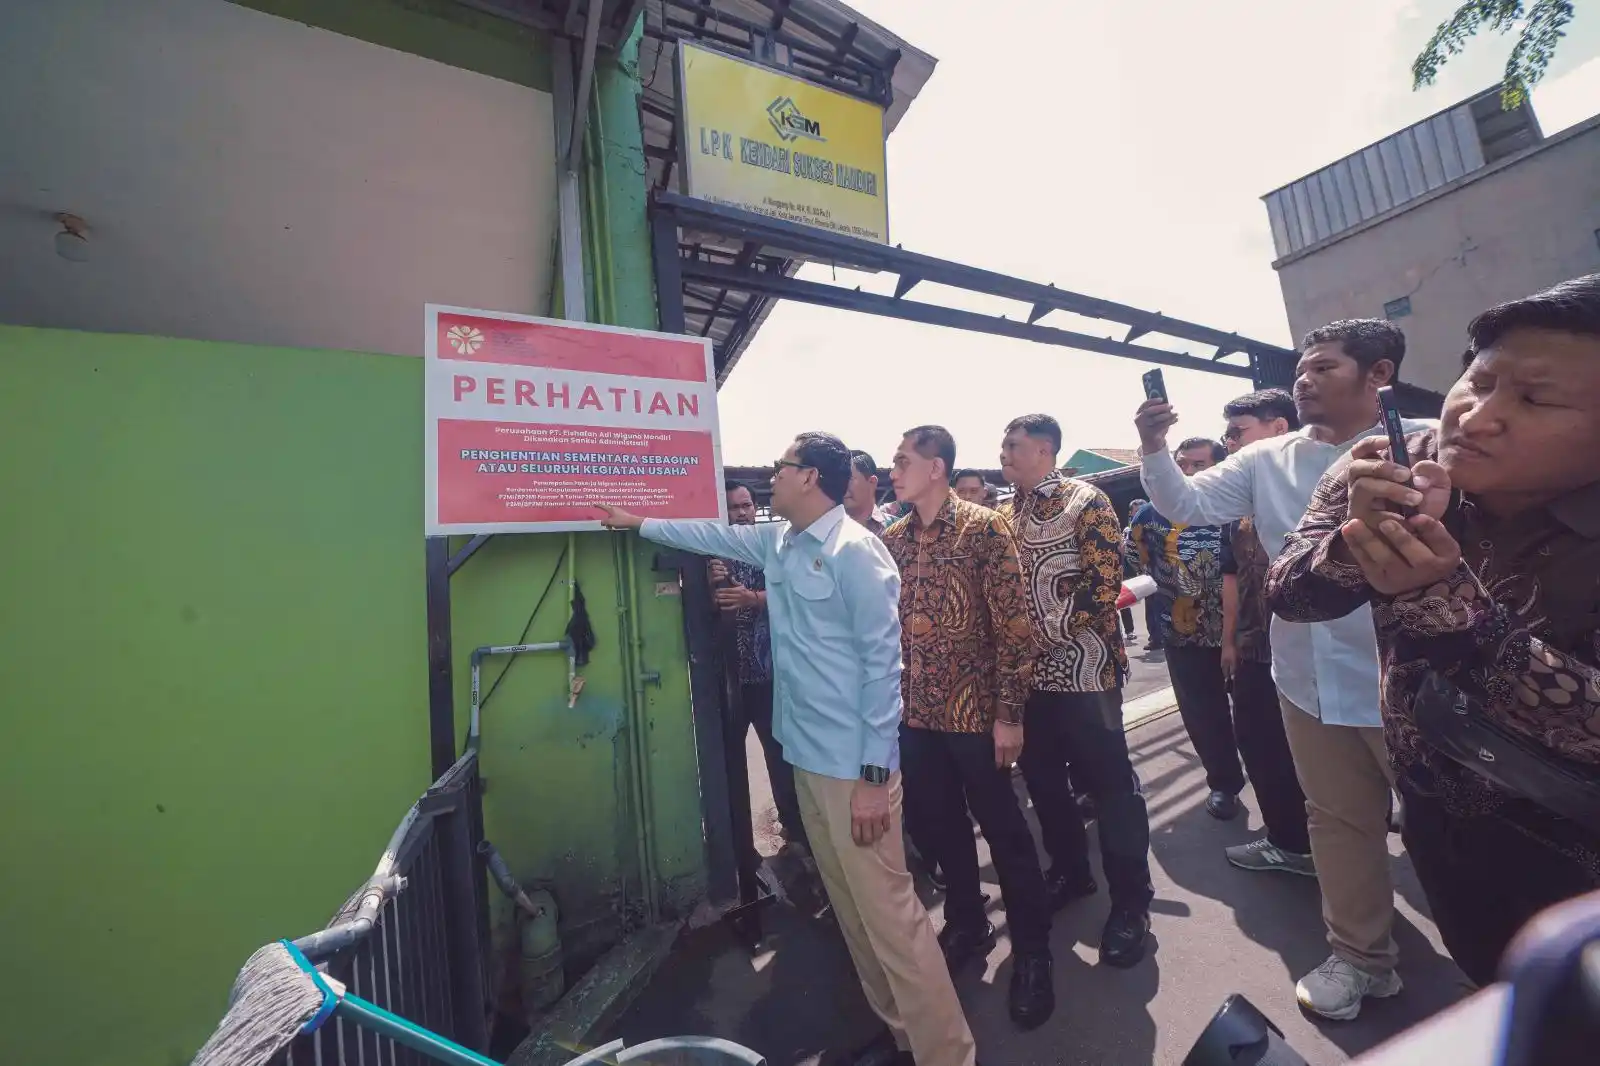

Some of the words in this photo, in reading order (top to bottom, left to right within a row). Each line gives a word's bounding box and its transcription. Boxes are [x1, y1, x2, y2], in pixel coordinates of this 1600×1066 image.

[740, 136, 791, 175] KENDARI
[793, 151, 834, 185] SUKSES
[836, 163, 878, 197] MANDIRI
[453, 375, 699, 418] PERHATIAN
[495, 427, 547, 435] Perusahaan
[524, 435, 569, 443] Dikenakan
[599, 439, 649, 447] Administratif
[461, 449, 560, 461] PENGHENTIAN
[564, 452, 639, 464] SEMENTARA
[641, 455, 699, 465] SEBAGIAN
[477, 463, 517, 473] ATAU
[521, 463, 580, 474] SELURUH
[583, 465, 645, 475] KEGIATAN
[648, 466, 688, 476] USAHA
